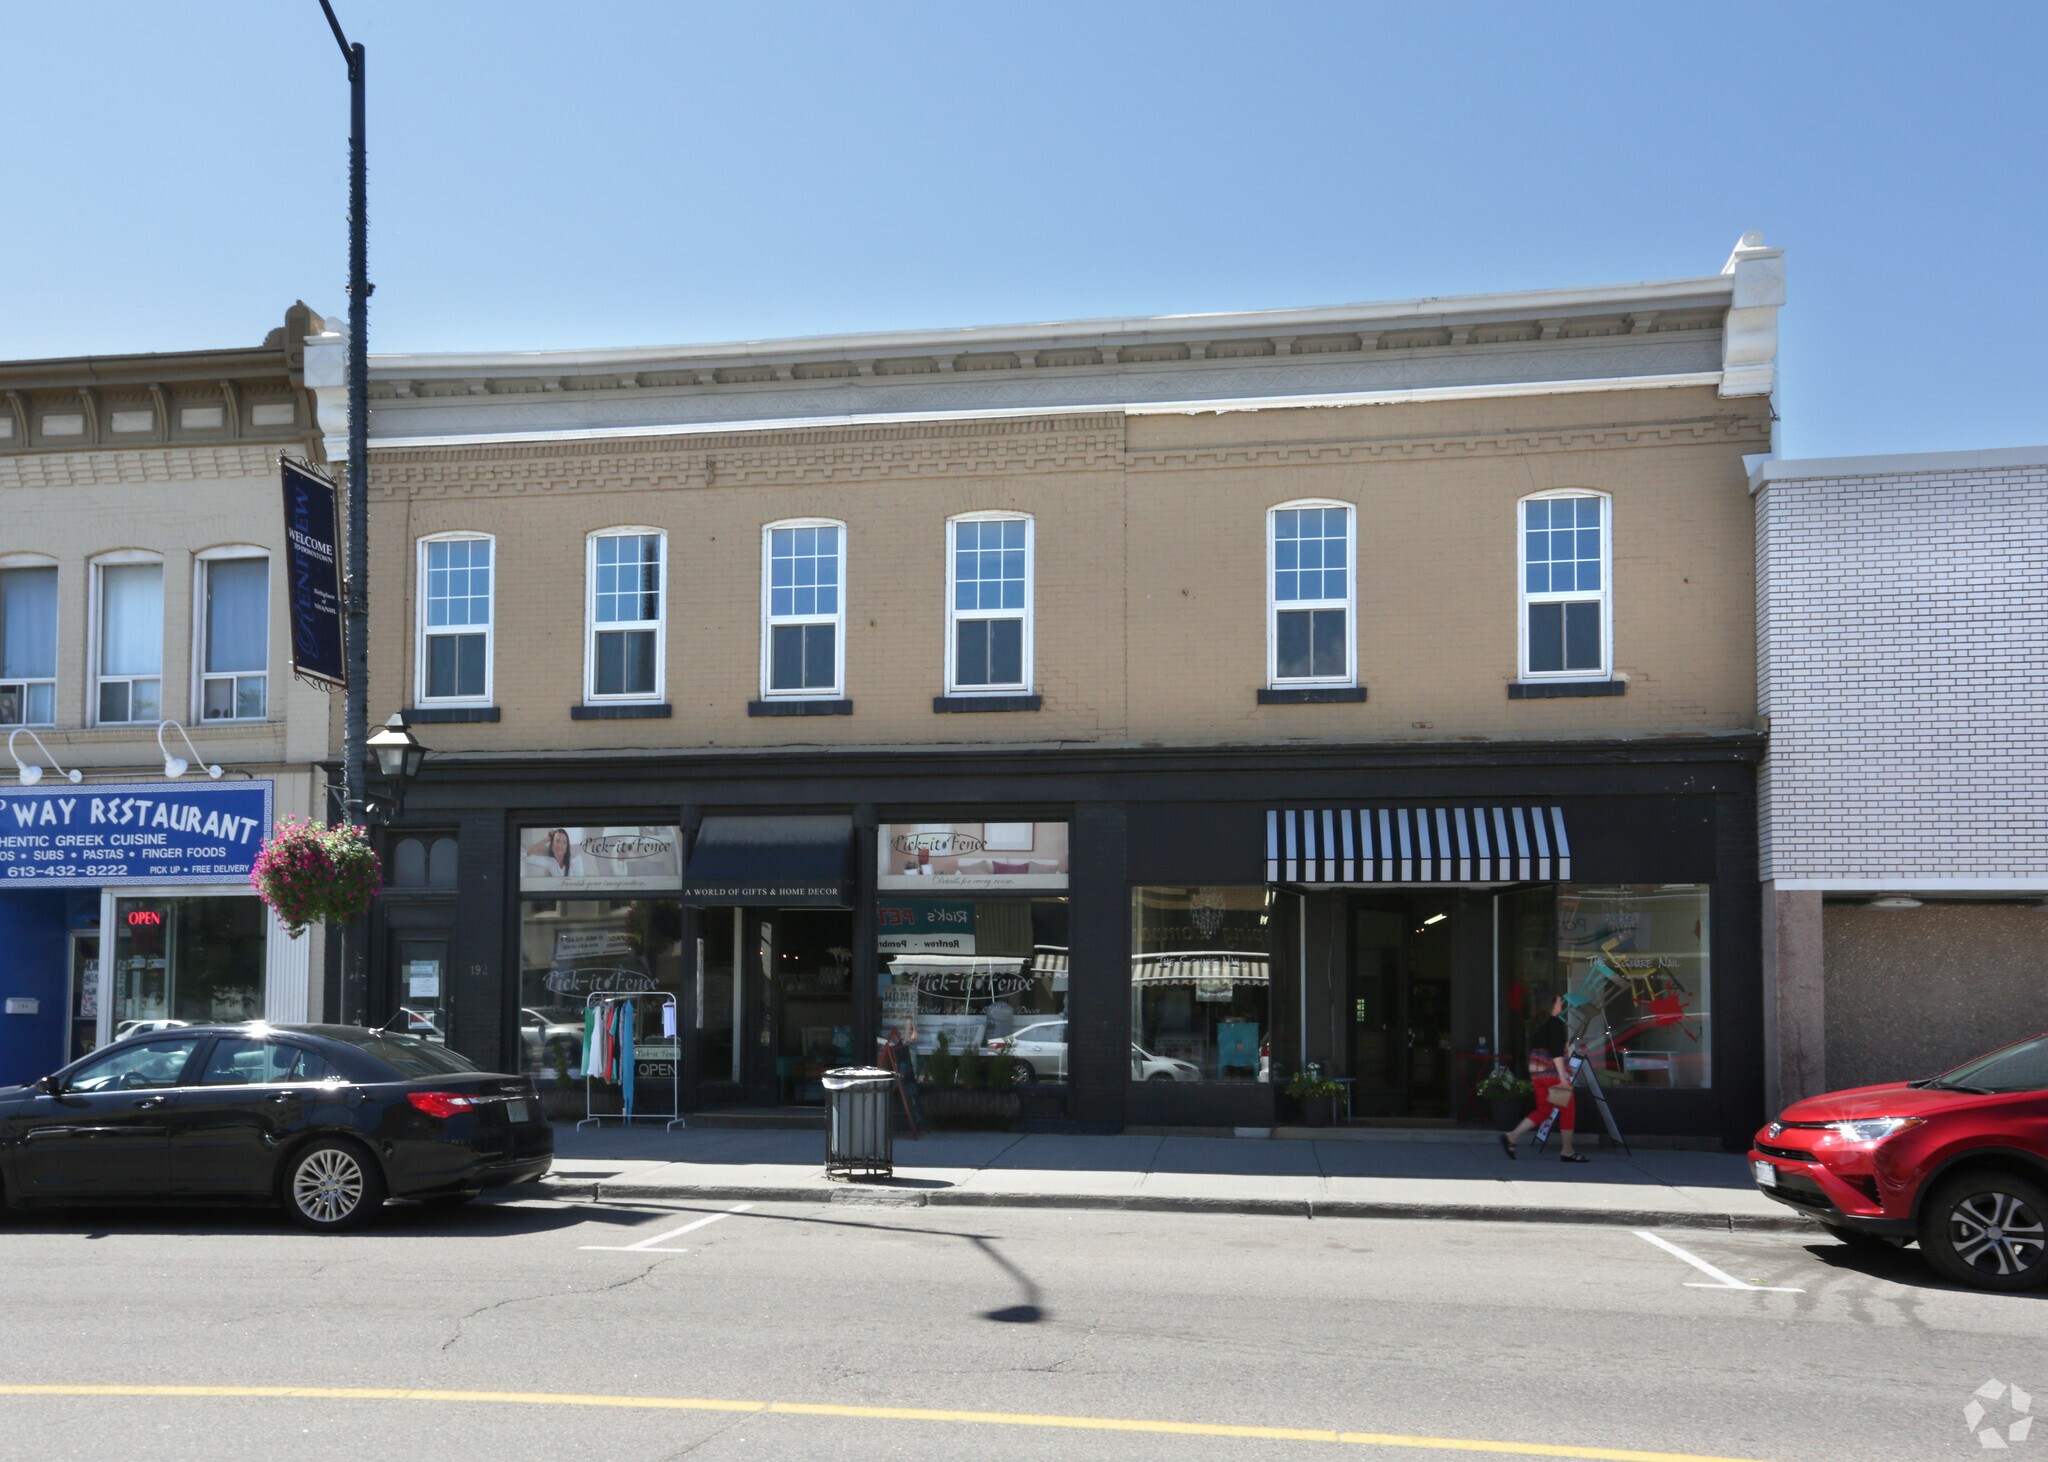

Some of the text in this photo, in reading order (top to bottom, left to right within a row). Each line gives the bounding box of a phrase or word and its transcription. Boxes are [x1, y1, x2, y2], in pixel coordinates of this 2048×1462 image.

[288, 526, 333, 556] WELCOME
[301, 545, 333, 565] DOWNTOWN
[12, 797, 259, 844] WAY RESTAURANT
[55, 834, 104, 846] GREEK
[110, 833, 167, 846] CUISINE
[632, 835, 671, 853] Fence
[946, 833, 988, 851] Fence
[33, 850, 64, 861] SUBS
[83, 849, 124, 860] PASTAS
[142, 848, 182, 859] FINGER
[186, 847, 226, 858] FOODS
[7, 865, 128, 878] 613-432-8222
[150, 864, 250, 875] PICK UP FREE DELIVERY
[973, 879, 991, 887] every
[693, 888, 726, 896] WORLD
[728, 888, 740, 896] OF
[741, 888, 768, 896] GIFTS
[769, 888, 777, 896] &
[779, 888, 806, 896] HOME
[807, 887, 839, 896] DECOR
[128, 911, 161, 925] OPEN
[1658, 955, 1681, 968] NAIL
[609, 967, 660, 991] Fence
[638, 1063, 677, 1076] OPEN
